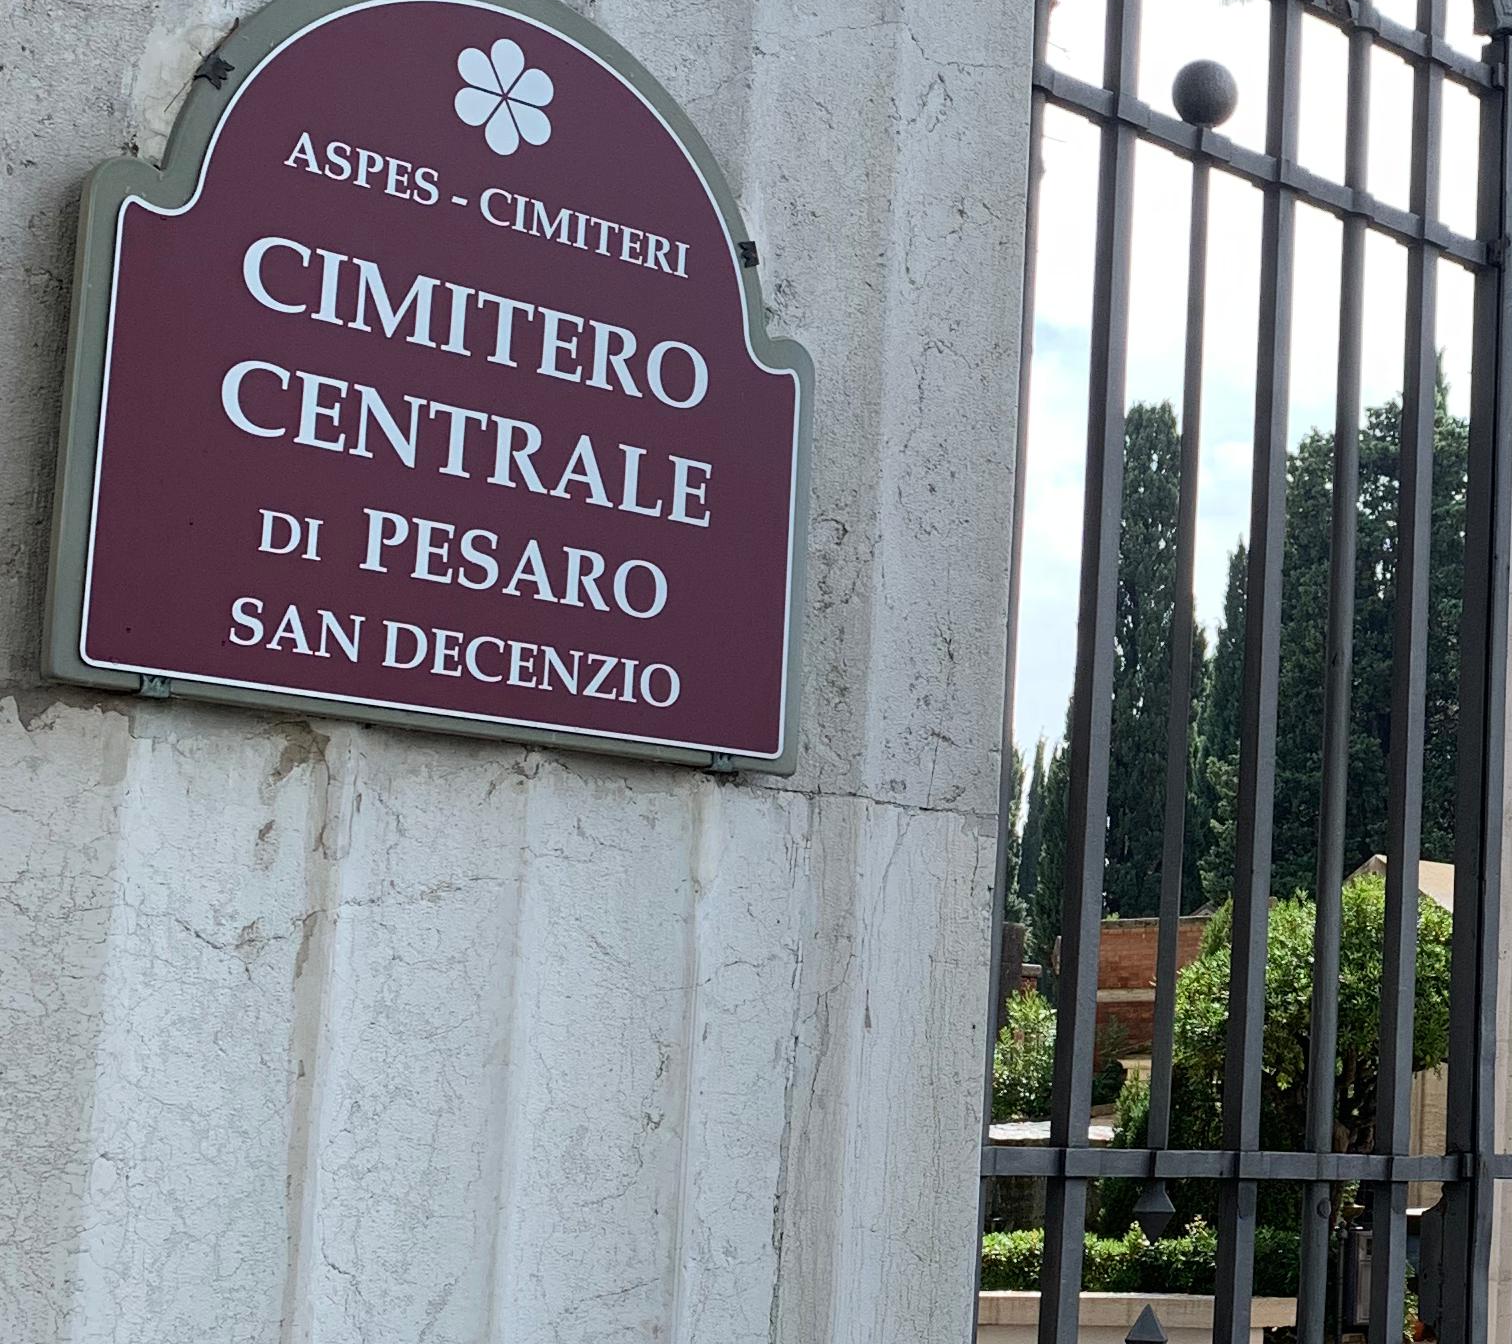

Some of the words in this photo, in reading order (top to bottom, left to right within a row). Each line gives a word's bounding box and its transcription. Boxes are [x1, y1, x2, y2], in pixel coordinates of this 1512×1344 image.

[284, 132, 438, 205] ASPES
[480, 189, 689, 279] CIMITERI
[243, 236, 709, 409] CIMITERO
[221, 360, 712, 528] CENTRALE
[259, 508, 324, 561] DI
[360, 507, 668, 619] PESARO
[230, 597, 365, 663] SAN
[382, 620, 681, 708] DECENZIO
